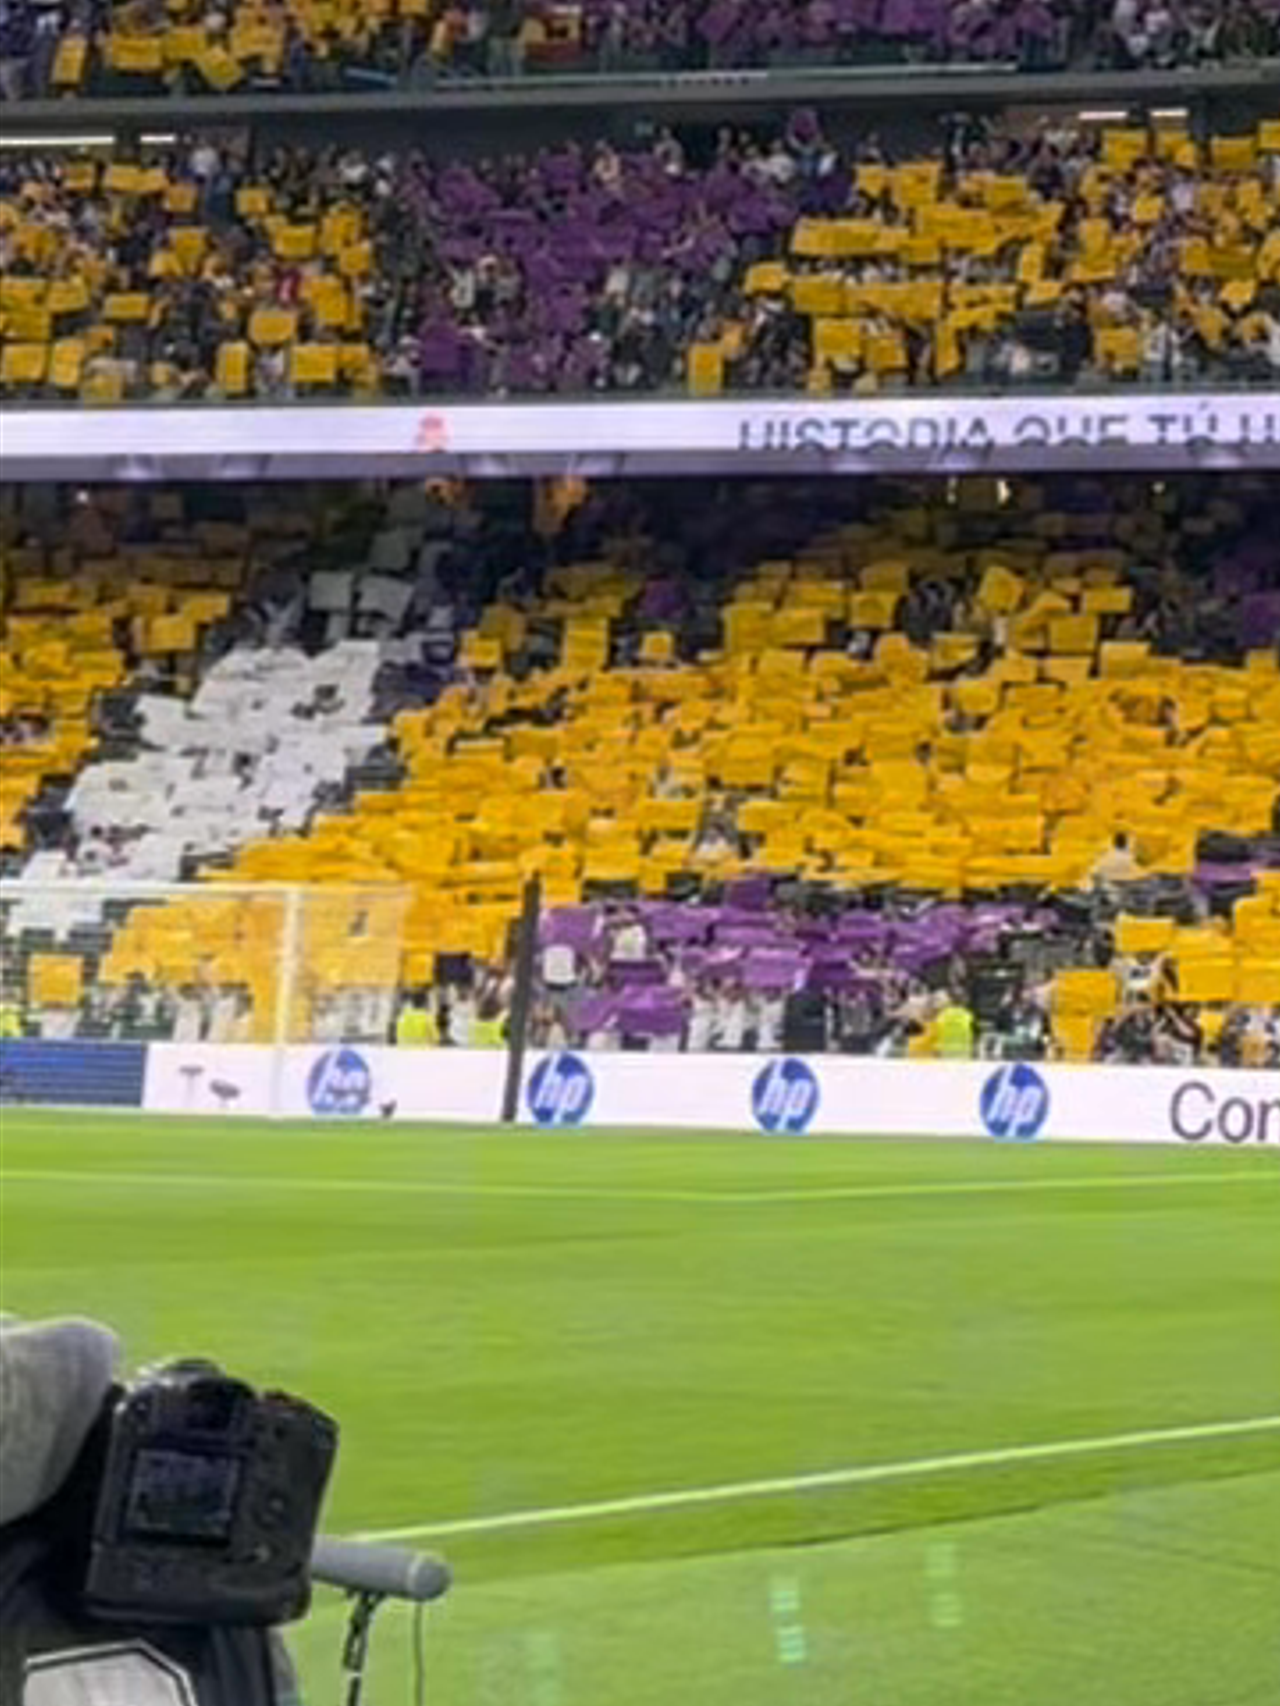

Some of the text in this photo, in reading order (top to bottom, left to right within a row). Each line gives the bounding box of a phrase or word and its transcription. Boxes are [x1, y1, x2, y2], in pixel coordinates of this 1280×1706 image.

[529, 1050, 592, 1127] hp
[754, 1056, 816, 1135] hp
[982, 1061, 1046, 1140] hp
